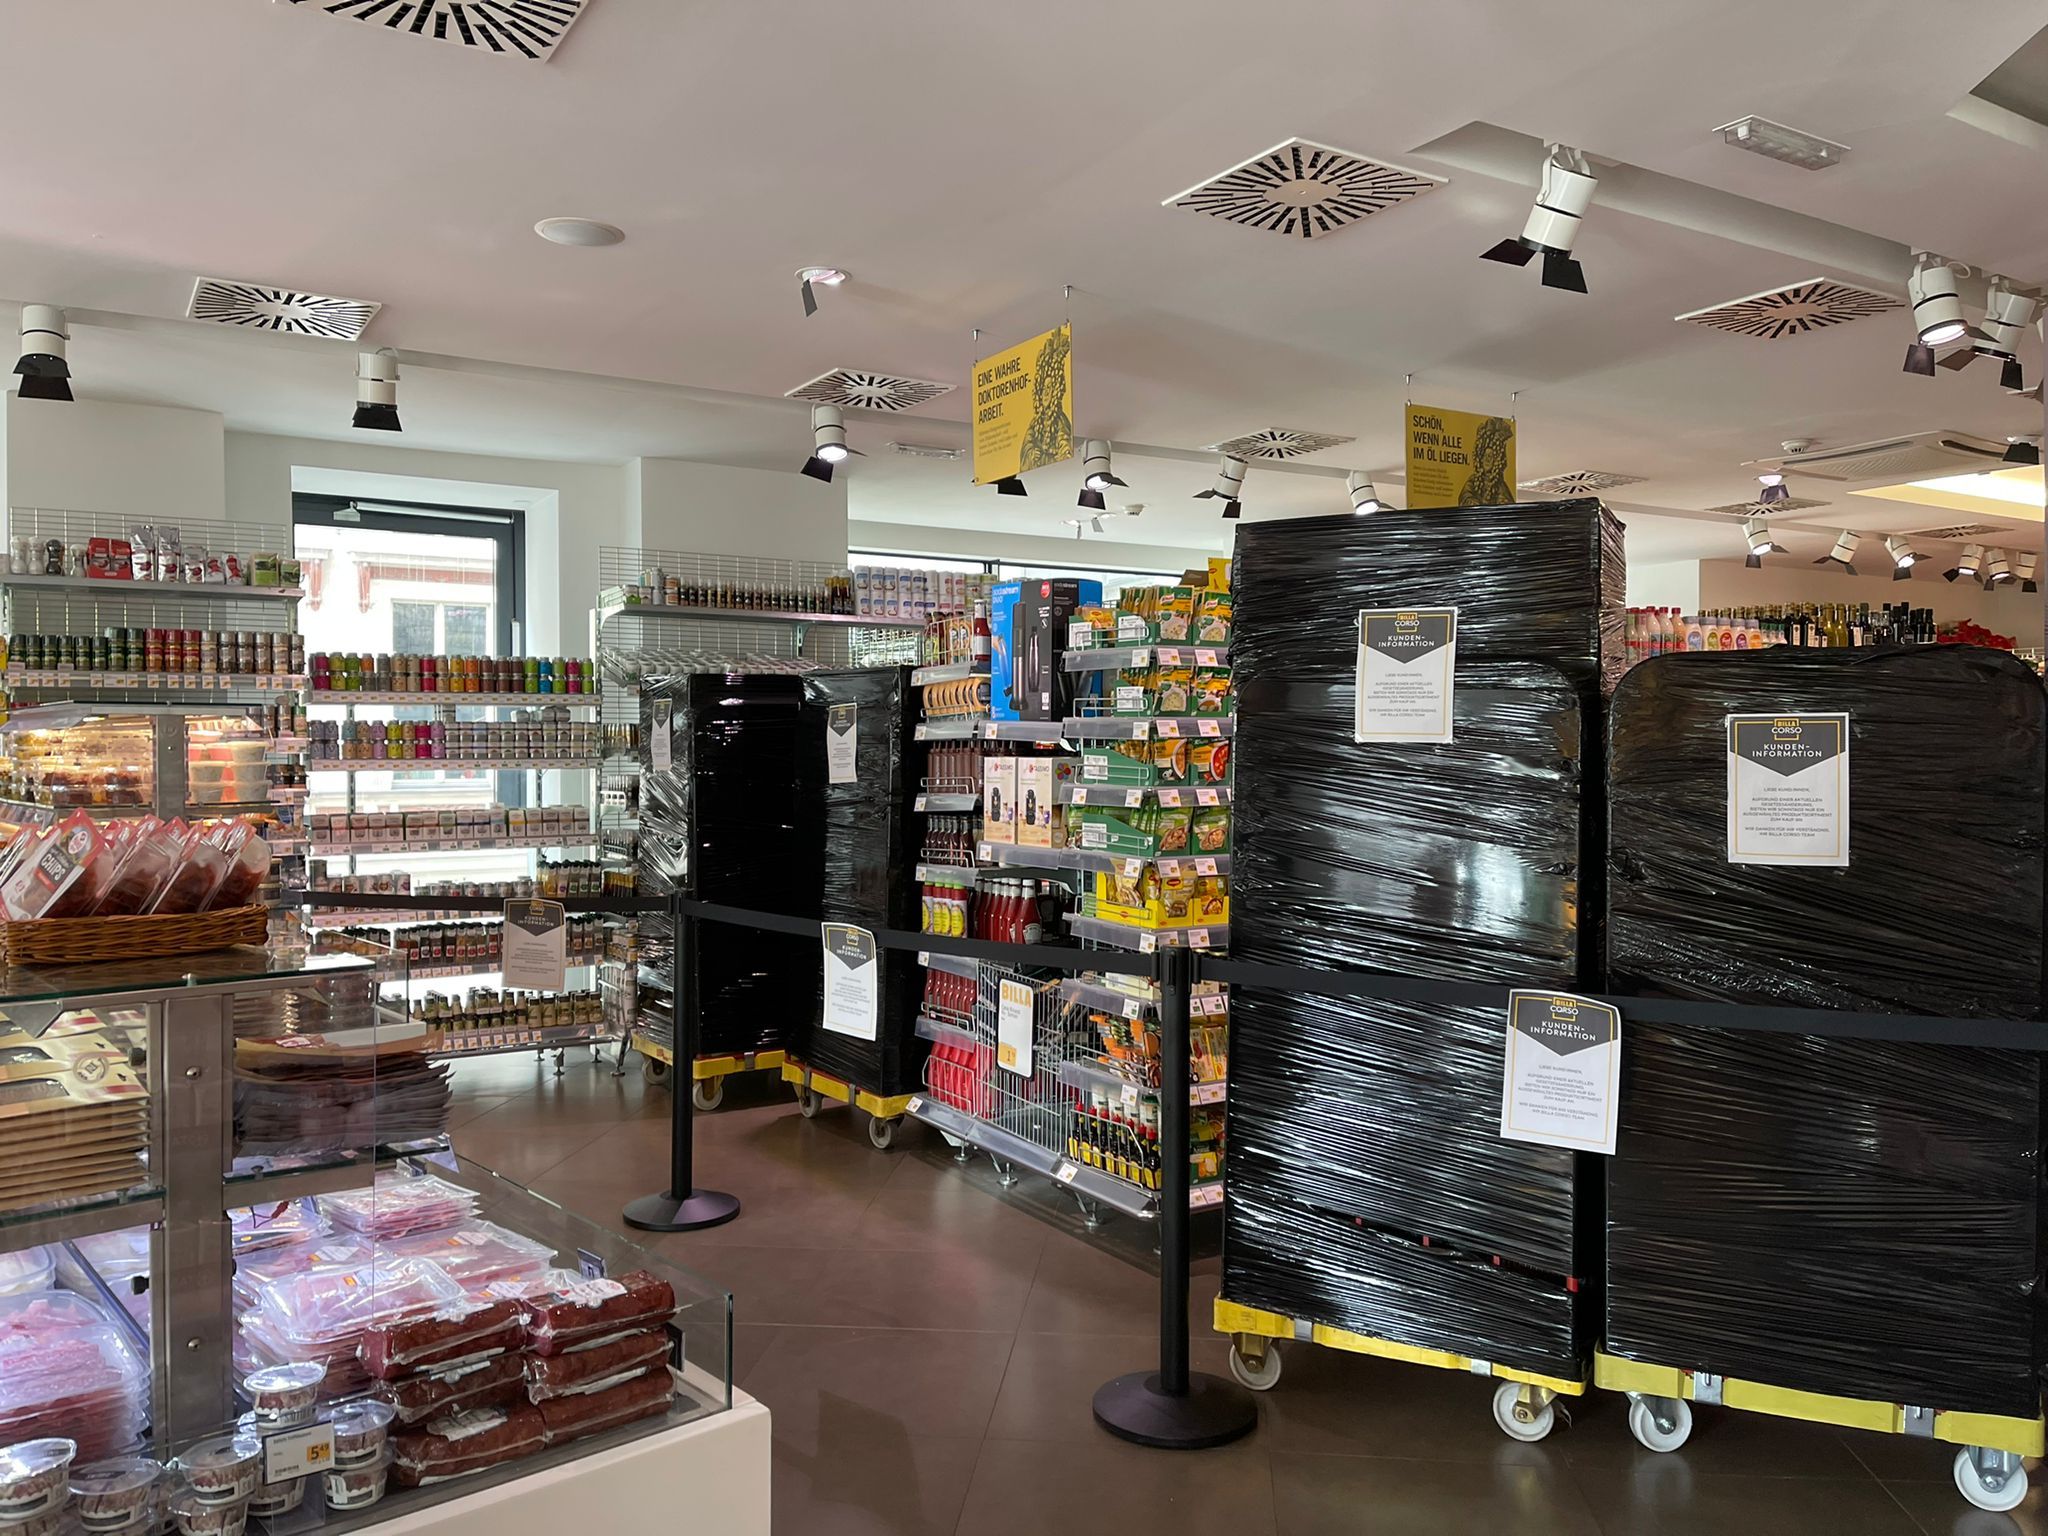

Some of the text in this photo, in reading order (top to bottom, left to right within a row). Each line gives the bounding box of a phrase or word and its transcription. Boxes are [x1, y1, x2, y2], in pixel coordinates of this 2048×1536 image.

[978, 357, 1021, 388] EINE WAHRE
[978, 373, 1031, 406] DOKTORENHOF-
[978, 402, 1004, 425] ARBEIT.
[1413, 415, 1445, 433] SCHÖN,
[1413, 431, 1462, 449] WENN ALLE
[1413, 446, 1470, 465] IM ÖL LIEGEN.
[41, 853, 66, 881] CHIPS
[1001, 982, 1031, 1008] BILLA
[1549, 1005, 1579, 1016] CORSO
[1530, 1026, 1596, 1041] INFORMATION
[1541, 1020, 1585, 1032] KUNDEN-
[311, 1445, 319, 1460] 5
